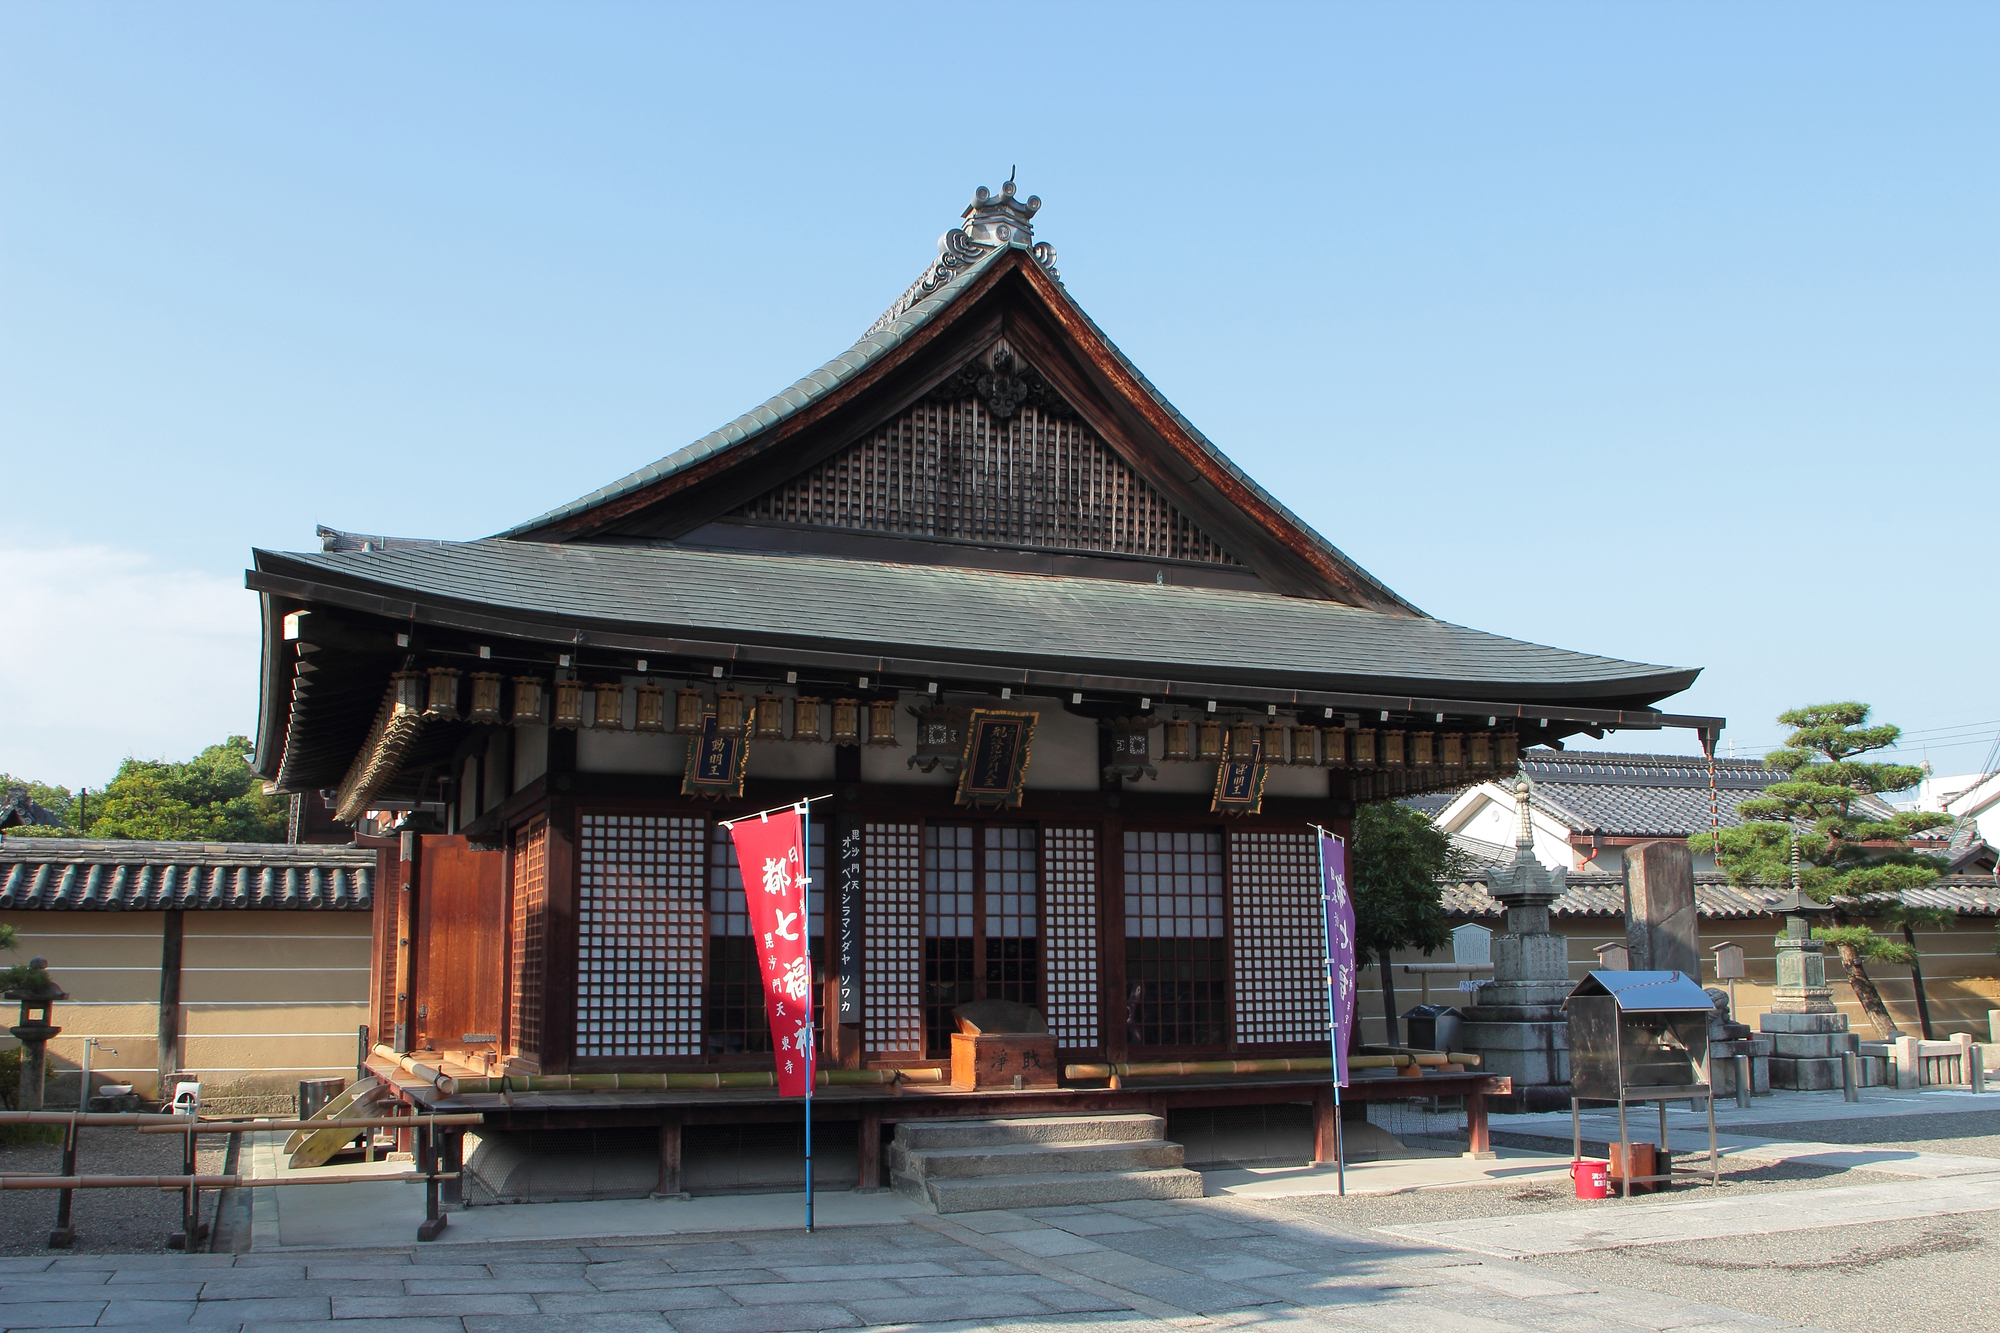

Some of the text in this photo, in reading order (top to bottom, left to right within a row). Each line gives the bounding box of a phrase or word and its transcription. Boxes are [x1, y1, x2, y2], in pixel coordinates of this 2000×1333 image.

[708, 737, 726, 776] 動明王
[841, 836, 852, 1012] オン ベイシラマンダヤ ソワカ
[851, 829, 861, 890] 毘沙門天
[762, 857, 815, 1061] 都七福神
[764, 932, 795, 1075] 毘沙門天 東寺
